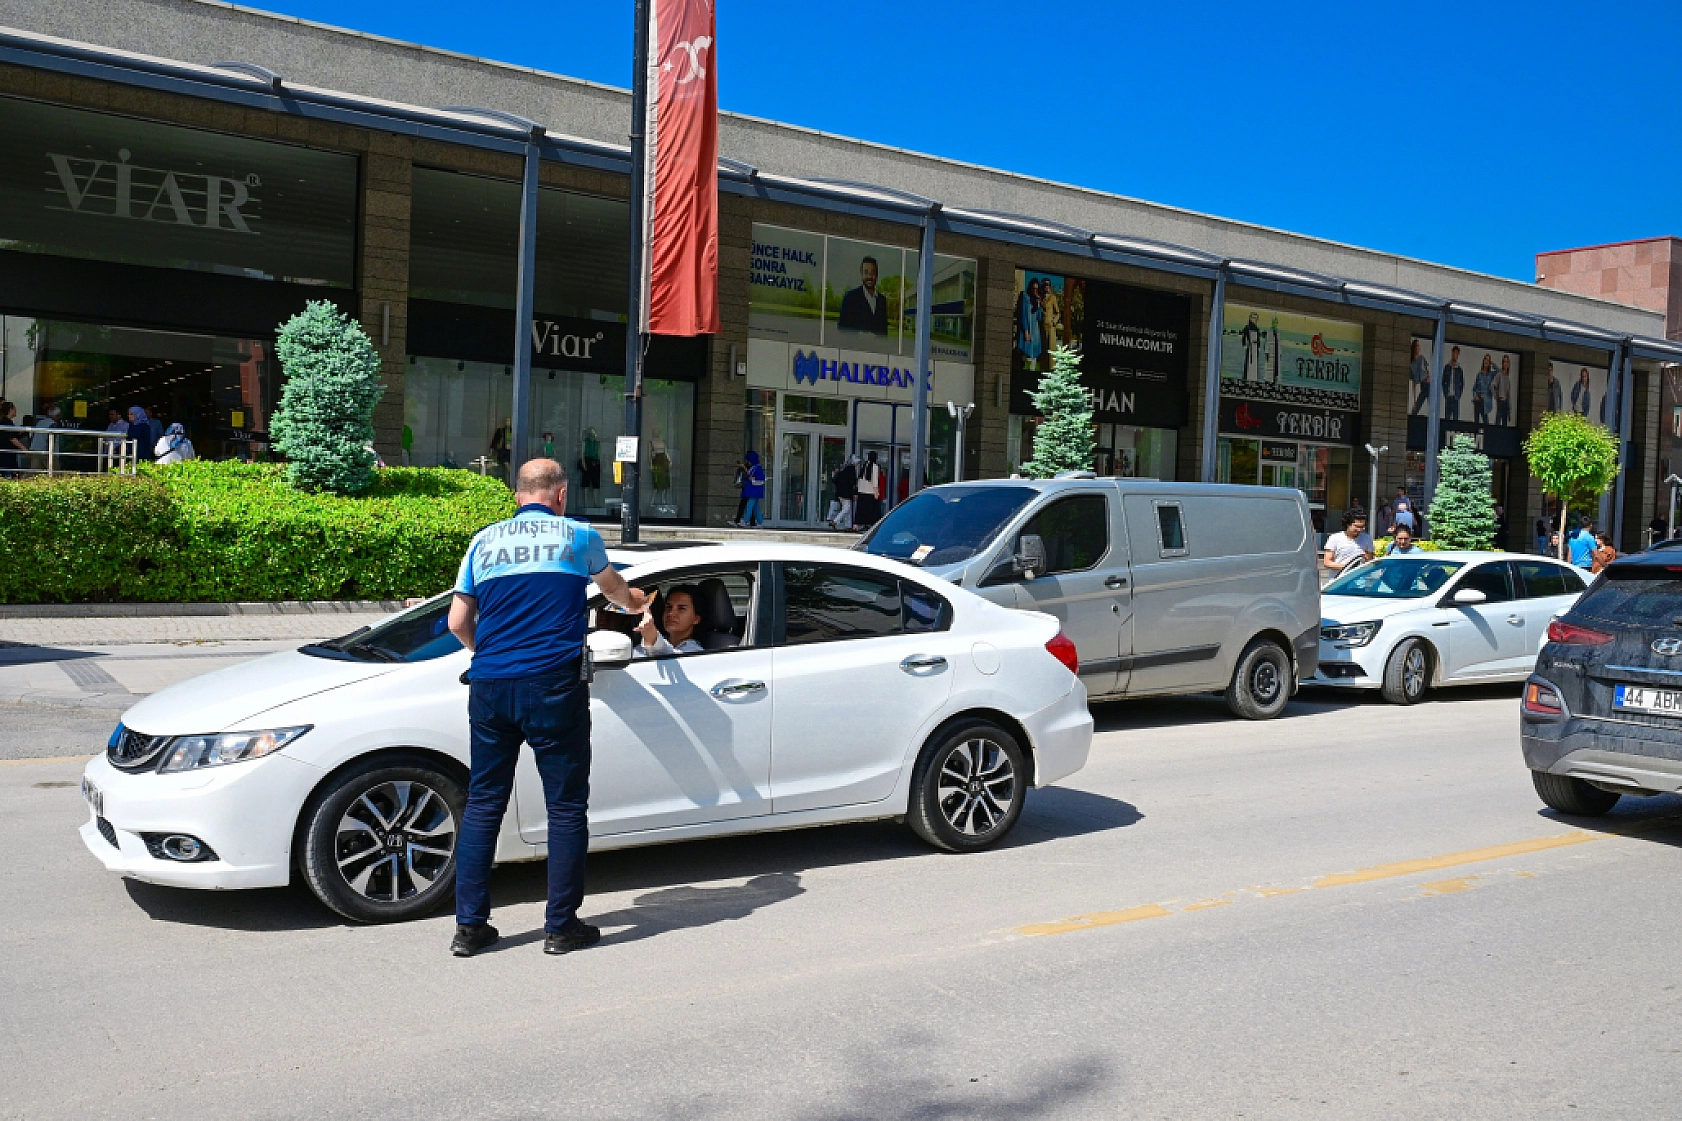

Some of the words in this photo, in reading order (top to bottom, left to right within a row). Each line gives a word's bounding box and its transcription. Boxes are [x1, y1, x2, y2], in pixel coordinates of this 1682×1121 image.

[531, 319, 598, 359] Viar
[1091, 388, 1136, 414] HAN
[480, 543, 575, 571] ZABITA
[1625, 687, 1644, 706] 44
